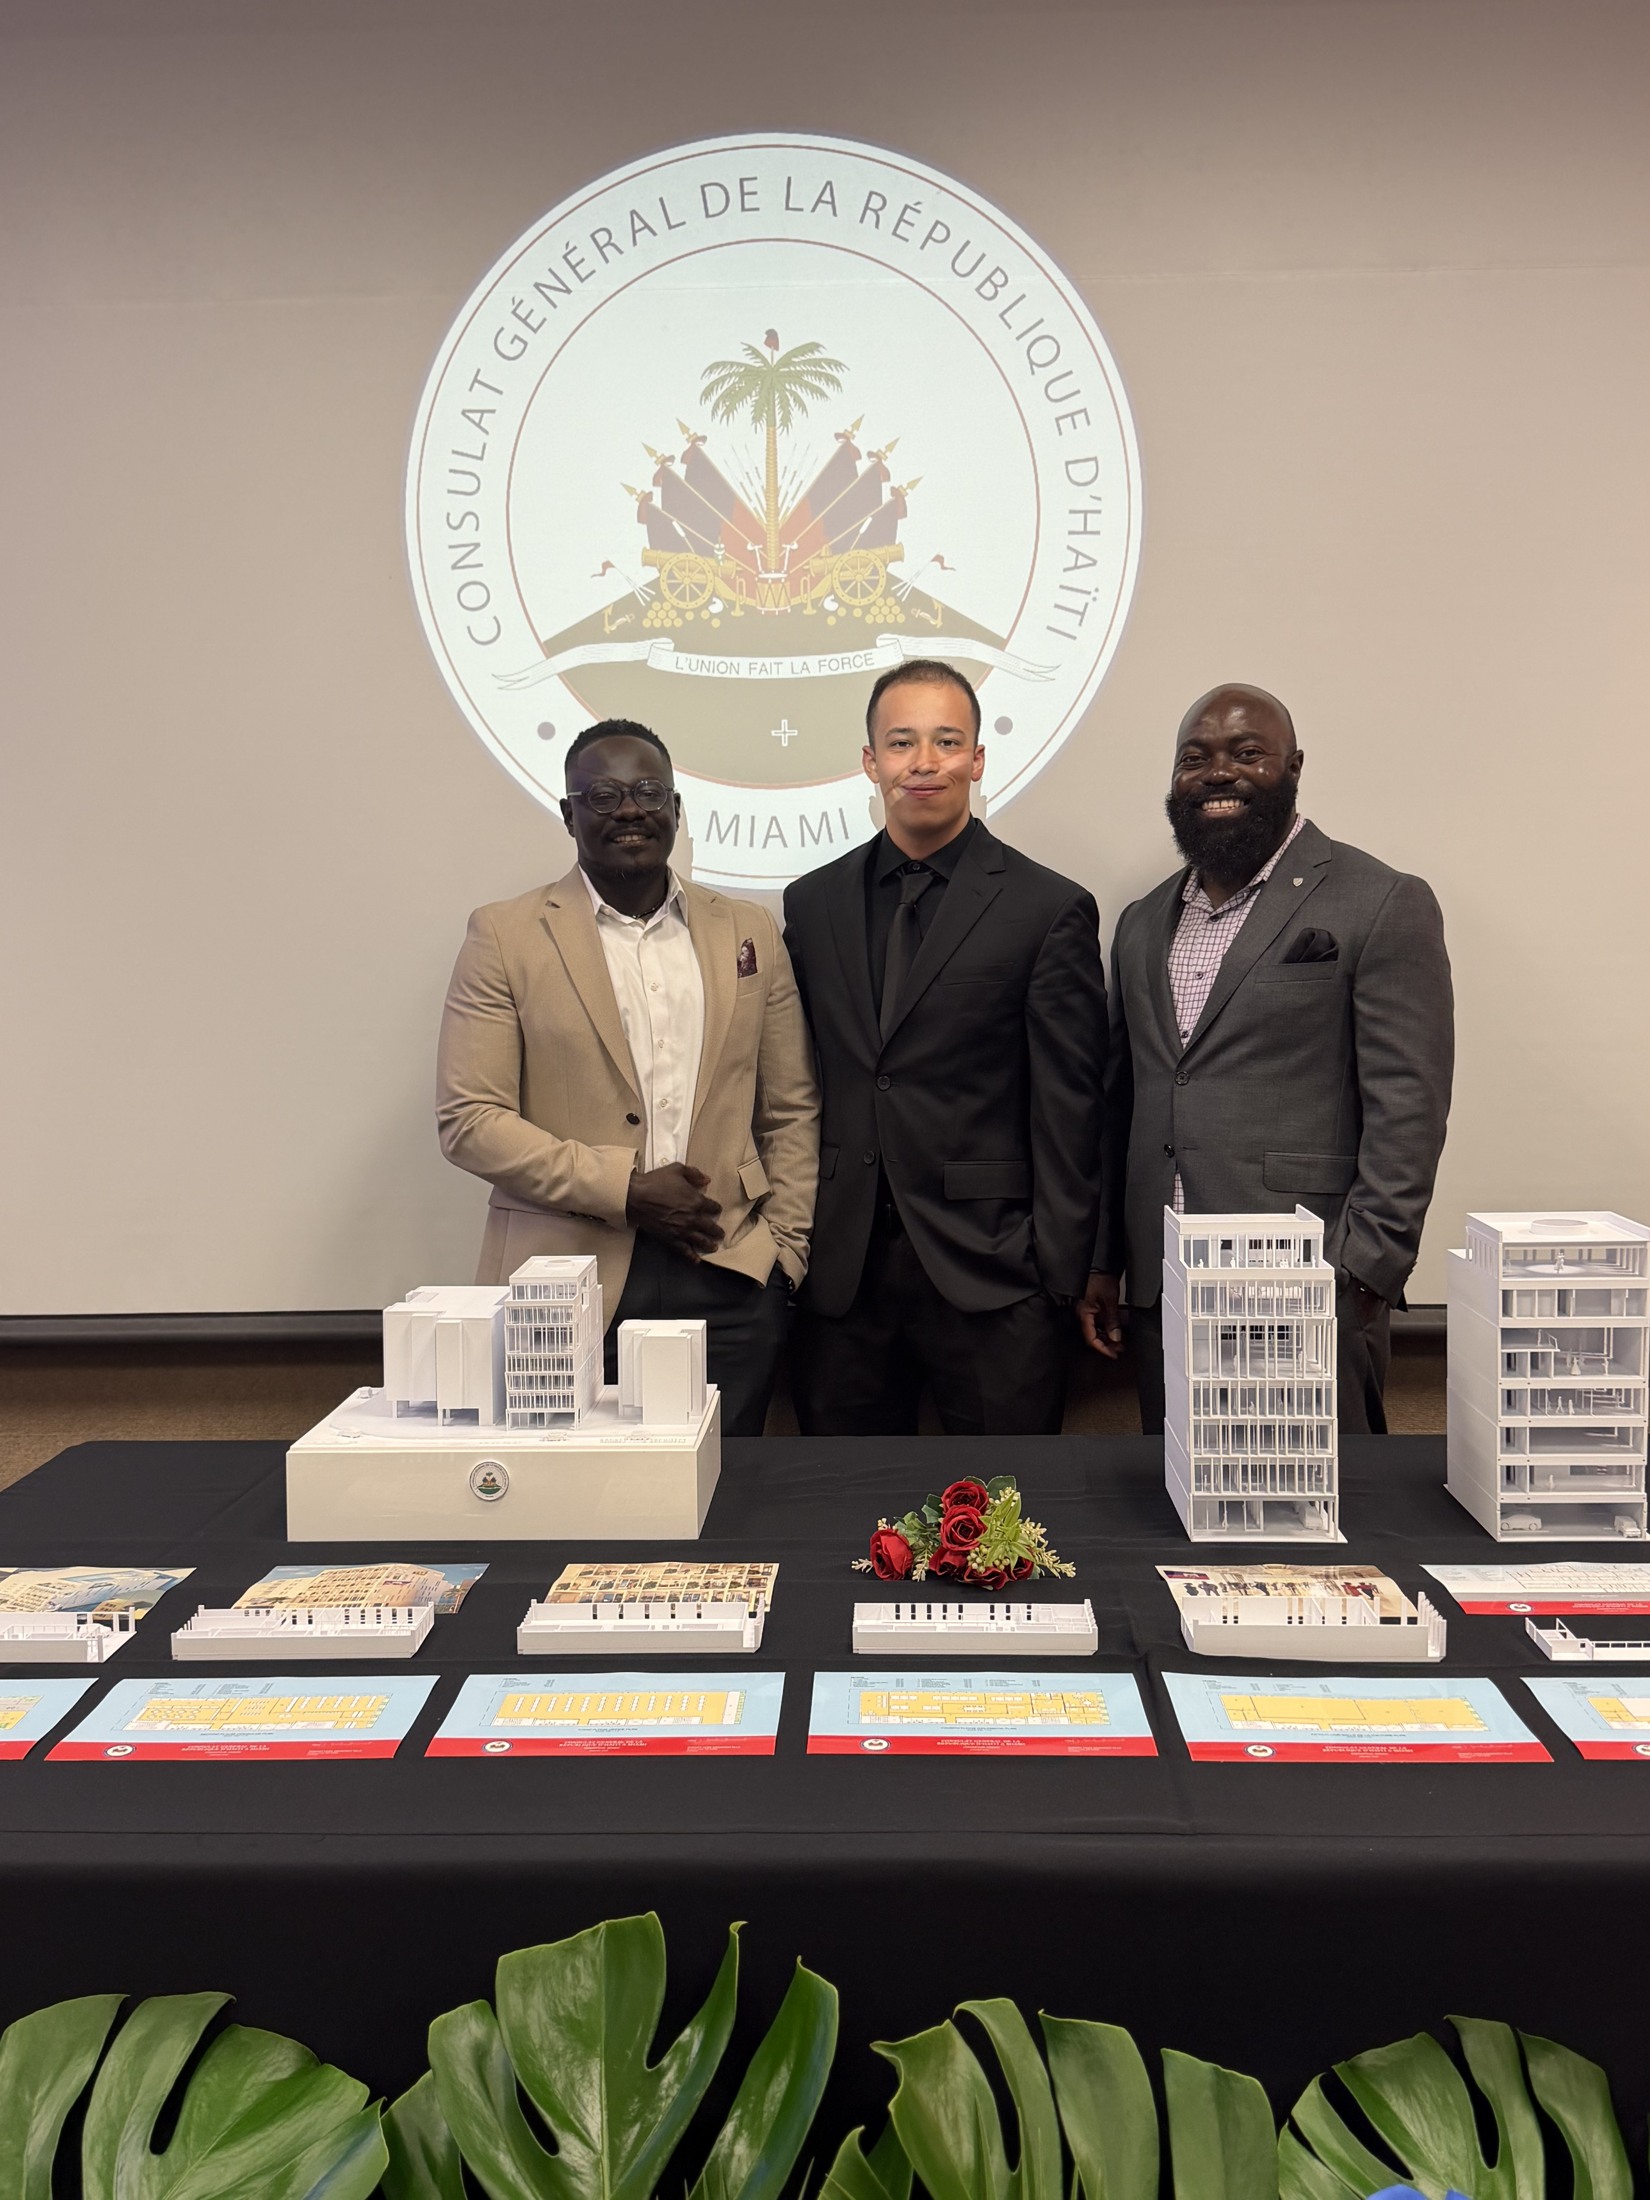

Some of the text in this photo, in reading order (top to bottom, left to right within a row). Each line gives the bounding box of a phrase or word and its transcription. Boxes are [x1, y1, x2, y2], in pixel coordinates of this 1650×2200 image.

[446, 176, 1102, 646] CONSULAT GÉNÉRAL DE LA RÉPUBLIQUE D'HAÏTI
[675, 652, 875, 676] L'UNION FAIT LA FORCE
[705, 808, 850, 849] MIAMI
